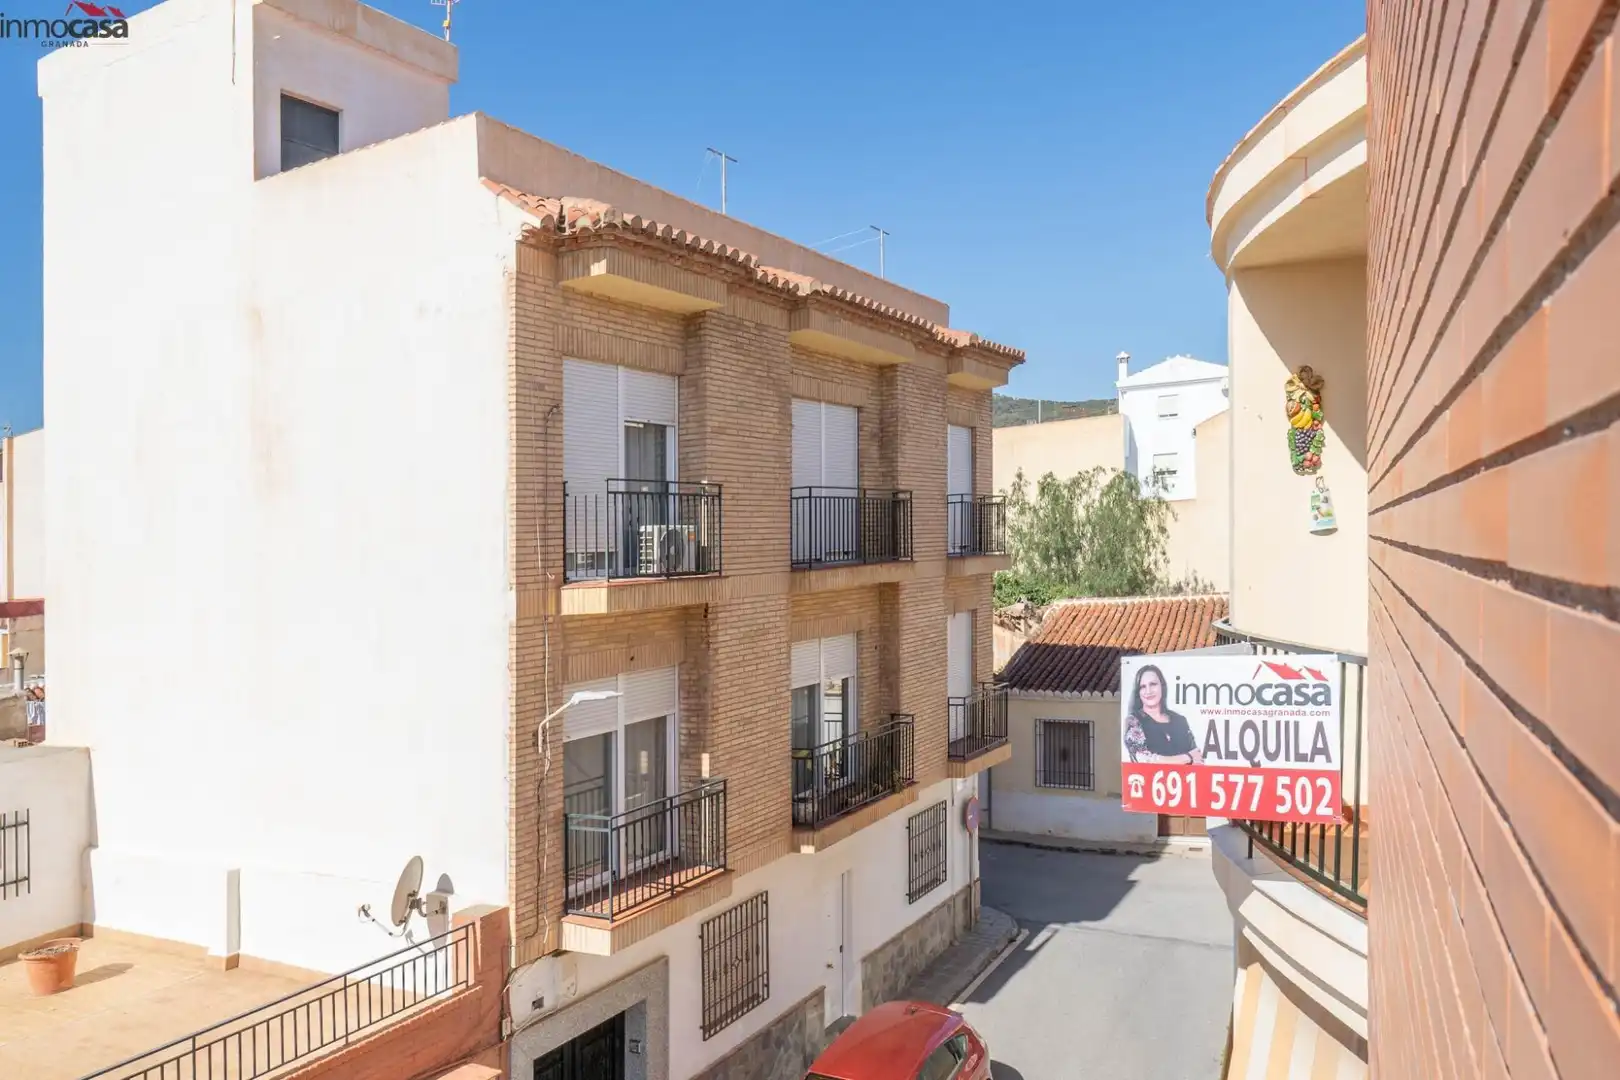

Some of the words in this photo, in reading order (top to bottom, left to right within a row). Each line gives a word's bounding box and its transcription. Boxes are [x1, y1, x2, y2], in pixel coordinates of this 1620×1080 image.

[1175, 675, 1332, 707] inmocasa
[1200, 708, 1331, 717] www.inmocasagranada.com
[1202, 719, 1332, 768] ALQUILA
[1151, 770, 1197, 808] 691
[1210, 773, 1264, 812] 577
[1275, 776, 1333, 816] 502
